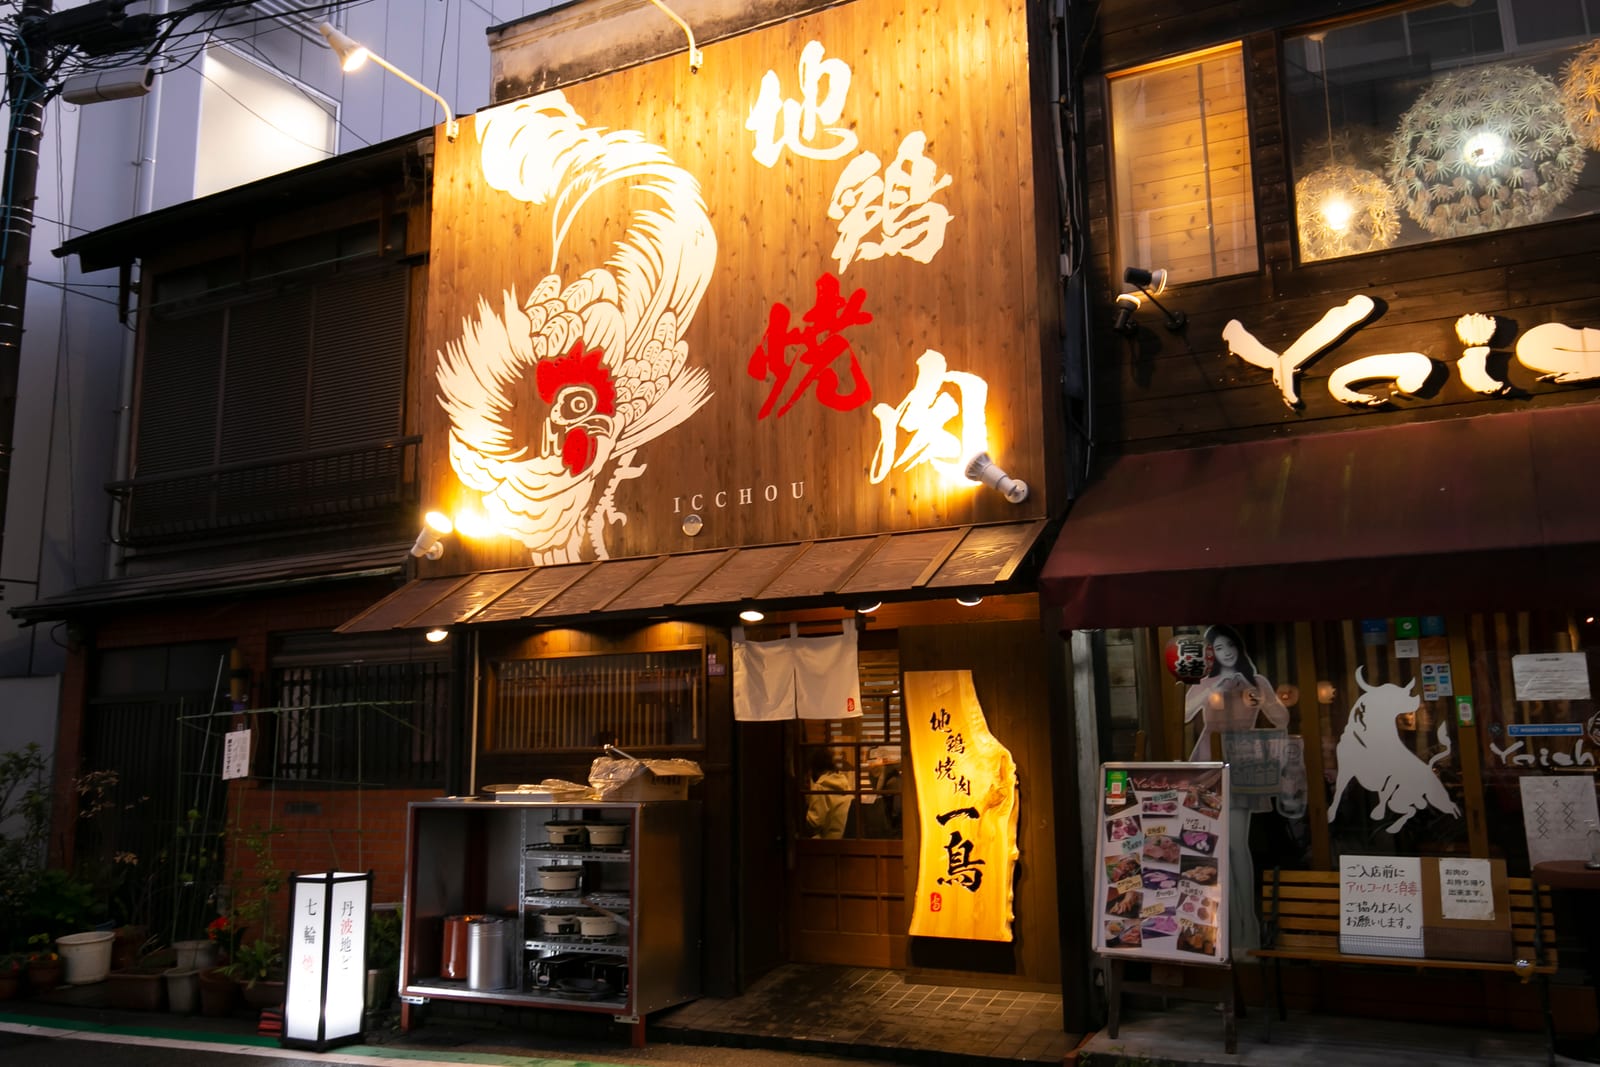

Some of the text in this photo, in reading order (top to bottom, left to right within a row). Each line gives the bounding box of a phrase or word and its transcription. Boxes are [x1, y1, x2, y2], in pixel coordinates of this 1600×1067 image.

[673, 481, 805, 513] ICCHOU
[1346, 864, 1406, 879] ご入店前に
[1345, 881, 1417, 897] アルコール消毒
[1446, 879, 1486, 887] お持ち帰り
[1345, 901, 1413, 914] ご協力よろしく
[1345, 915, 1412, 930] お願いします。
